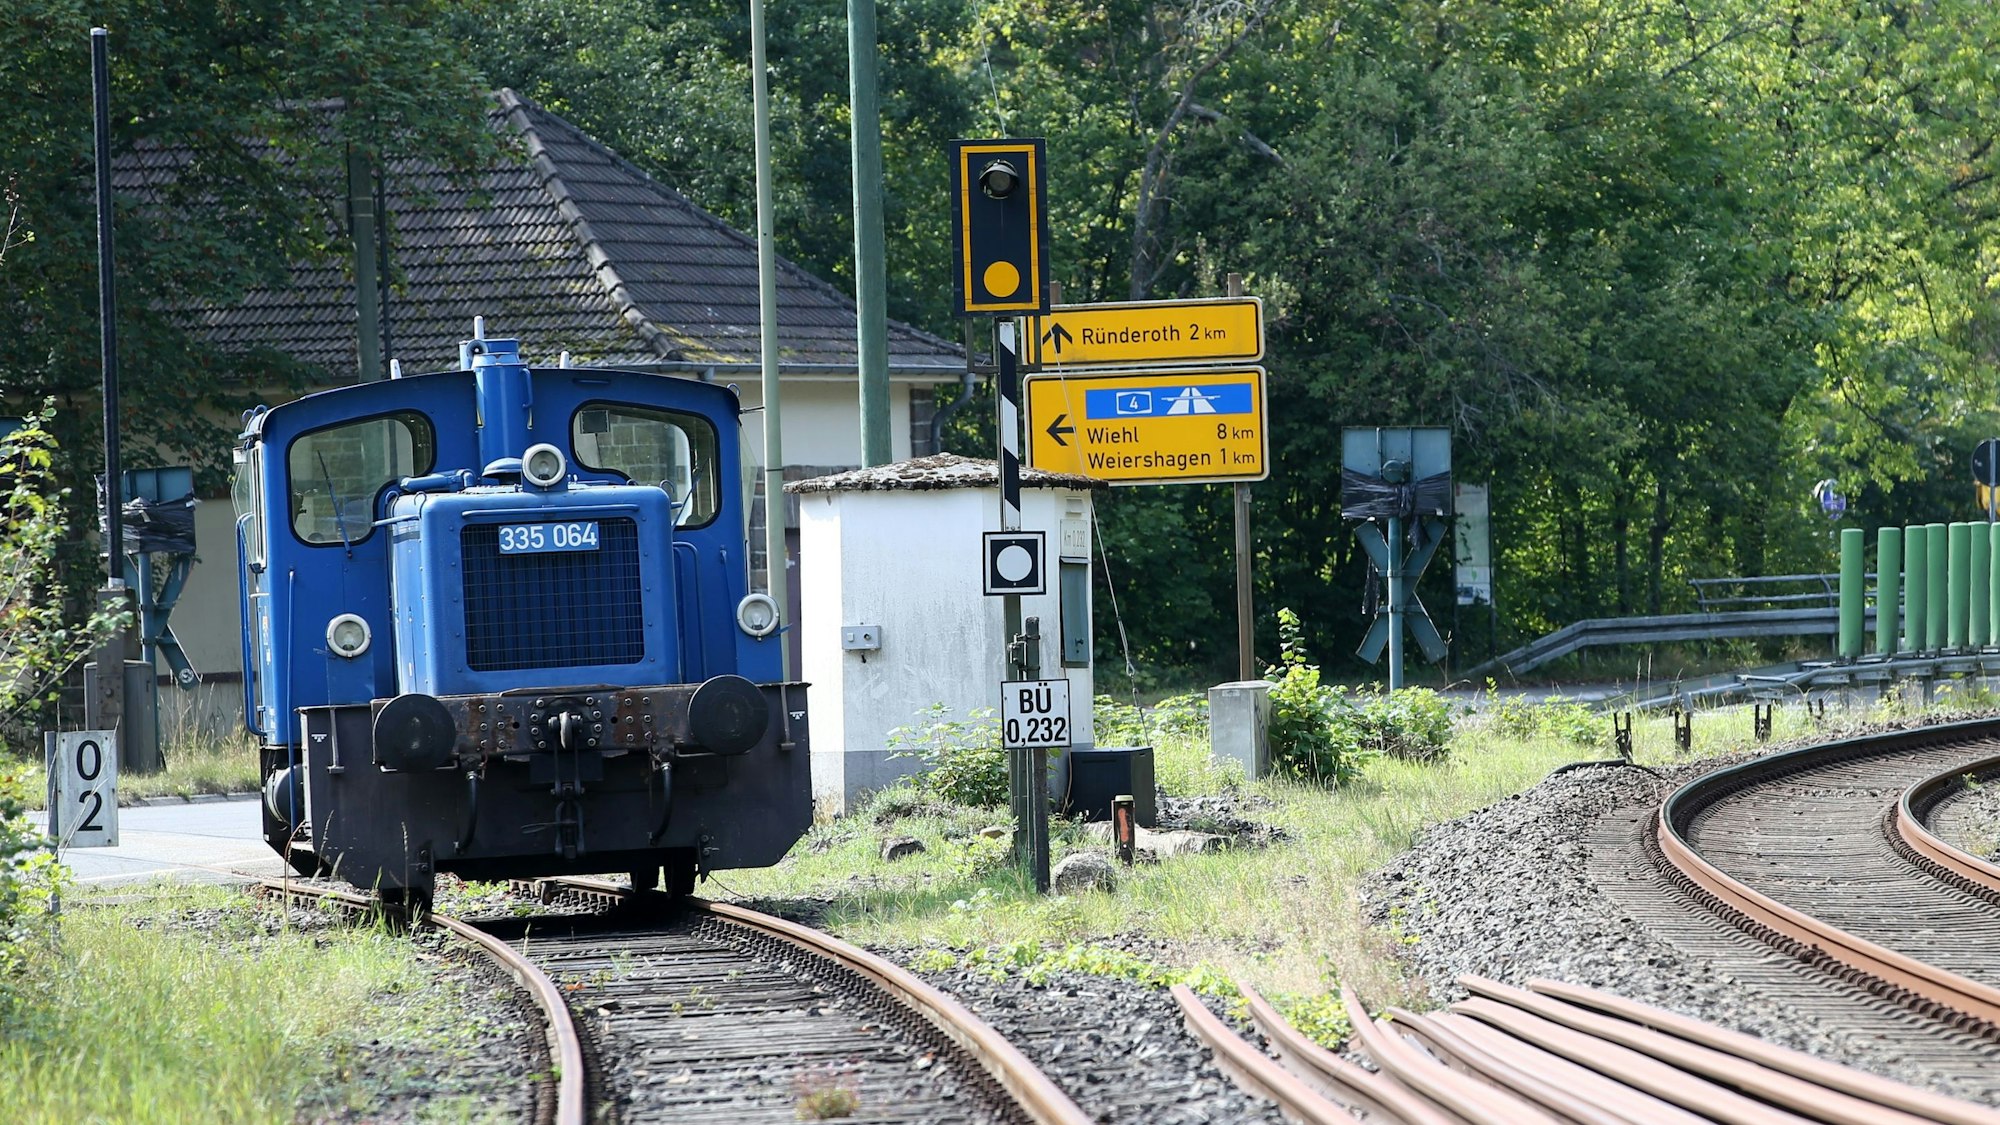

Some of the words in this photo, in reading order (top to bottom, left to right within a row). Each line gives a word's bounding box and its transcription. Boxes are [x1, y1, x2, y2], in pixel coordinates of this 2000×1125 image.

[1082, 325, 1180, 345] Ründeroth
[1190, 324, 1200, 340] 2
[1204, 328, 1226, 340] km
[1129, 396, 1138, 410] 4
[1087, 426, 1139, 444] Wiehl
[1217, 423, 1227, 440] 8
[1232, 427, 1254, 440] km
[1088, 451, 1211, 471] Weiershagen
[1220, 448, 1227, 465] 1
[1233, 452, 1255, 465] km
[500, 525, 545, 551] 335
[553, 523, 597, 548] 064
[1019, 682, 1052, 713] BÜ
[1007, 716, 1067, 746] 0,232
[76, 740, 102, 781] 0
[77, 790, 103, 832] 2
